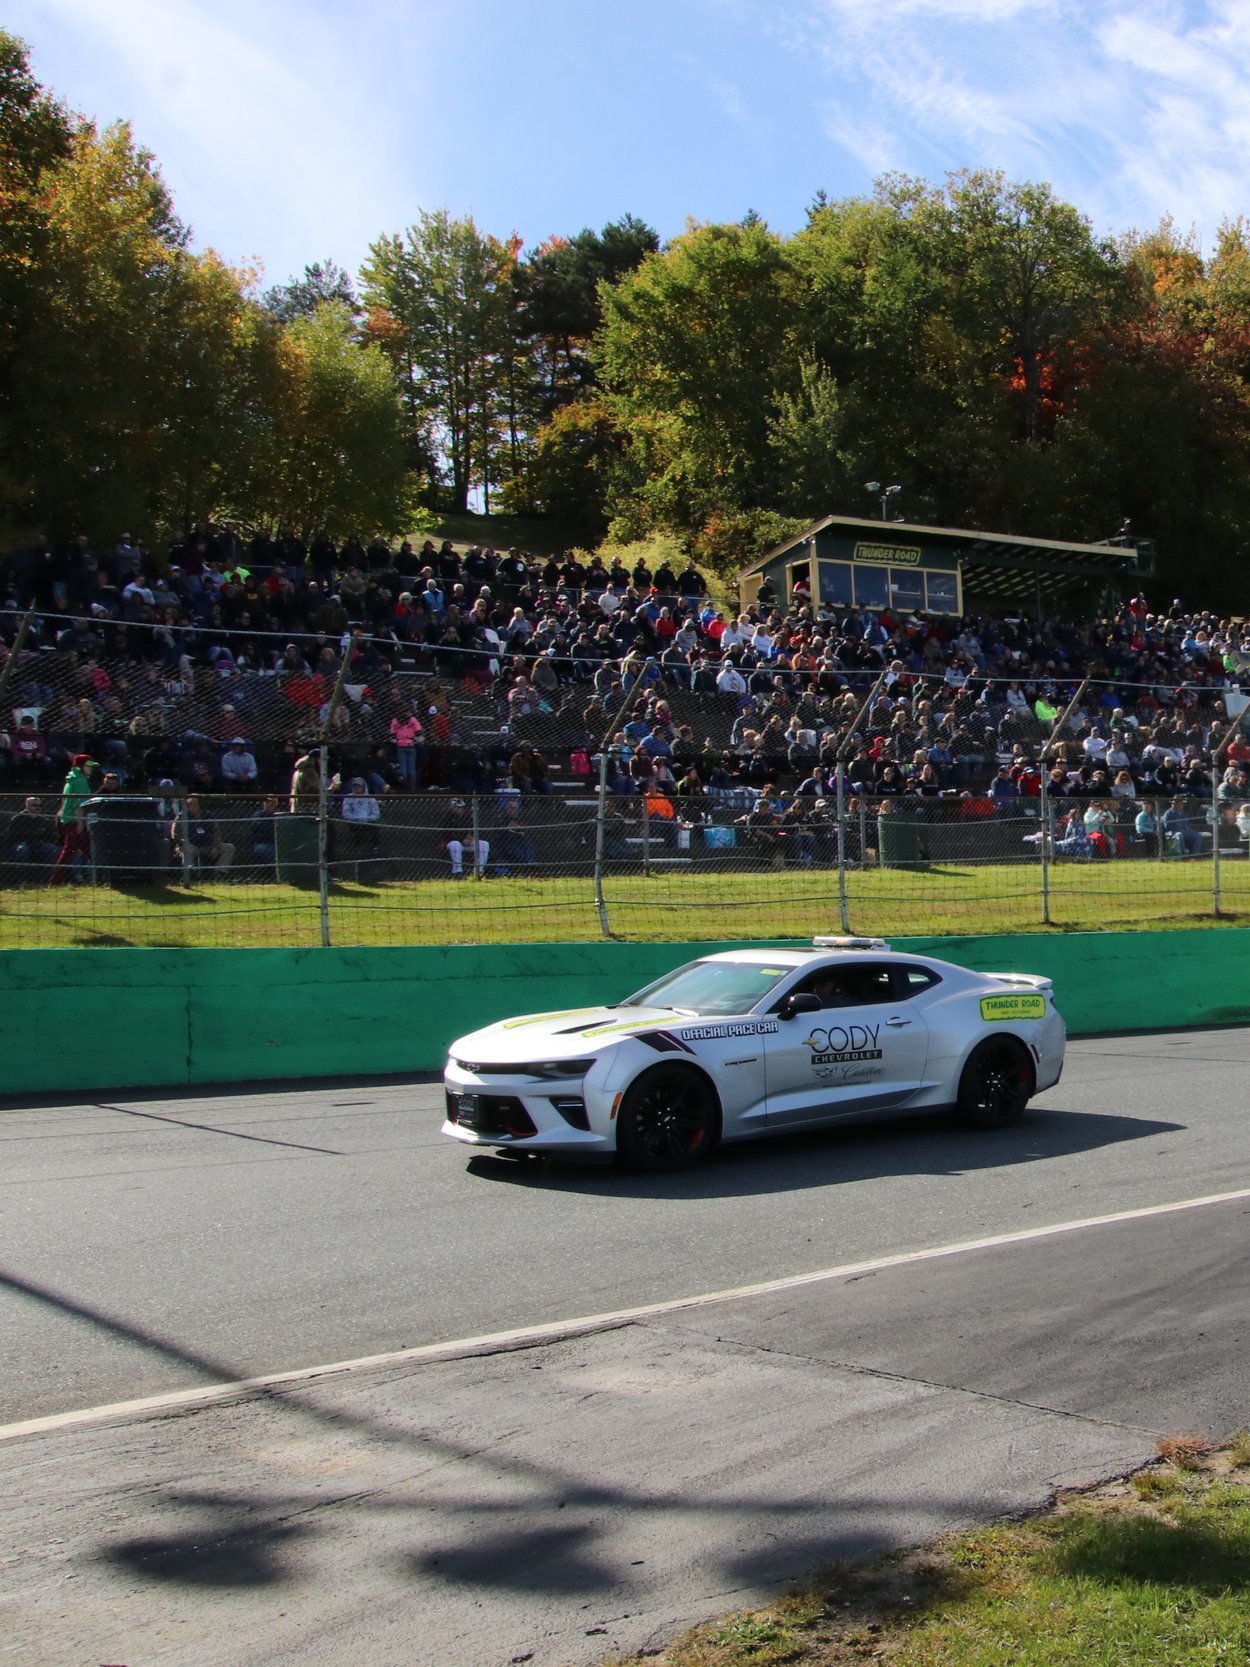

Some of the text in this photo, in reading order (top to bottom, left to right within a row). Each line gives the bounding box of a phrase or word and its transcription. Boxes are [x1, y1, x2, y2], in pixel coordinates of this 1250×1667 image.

[858, 546, 917, 561] THUNDER ROAD
[985, 999, 1041, 1010] THUNDER ROAD
[682, 1026, 727, 1040] OFFICIAL
[727, 1023, 756, 1037] PACE
[757, 1021, 779, 1034] CAR
[809, 1023, 880, 1054] CODY
[814, 1050, 879, 1064] CHEVROLET
